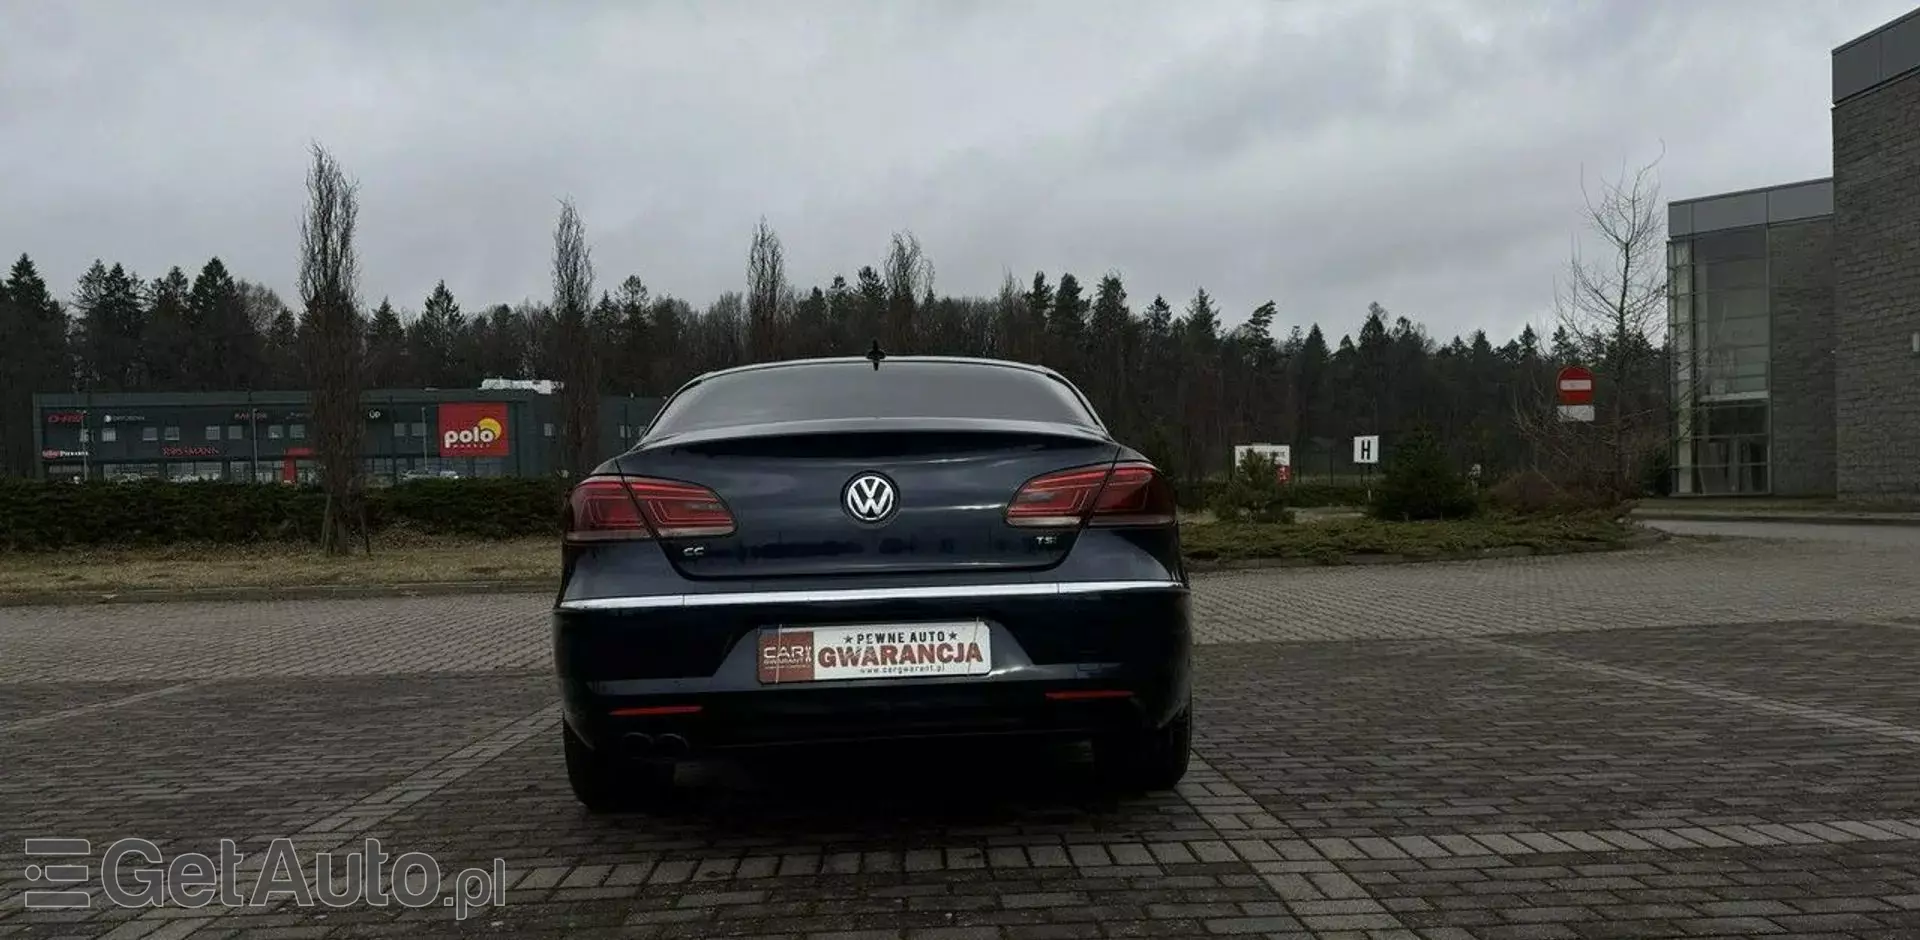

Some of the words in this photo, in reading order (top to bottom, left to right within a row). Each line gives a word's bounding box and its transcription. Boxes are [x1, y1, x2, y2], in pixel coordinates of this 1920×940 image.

[444, 426, 494, 449] polo
[1361, 439, 1371, 461] H
[856, 632, 905, 644] PEWNE
[909, 631, 945, 643] AUTO
[763, 645, 804, 658] CAR
[817, 642, 984, 668] GWARANCJA
